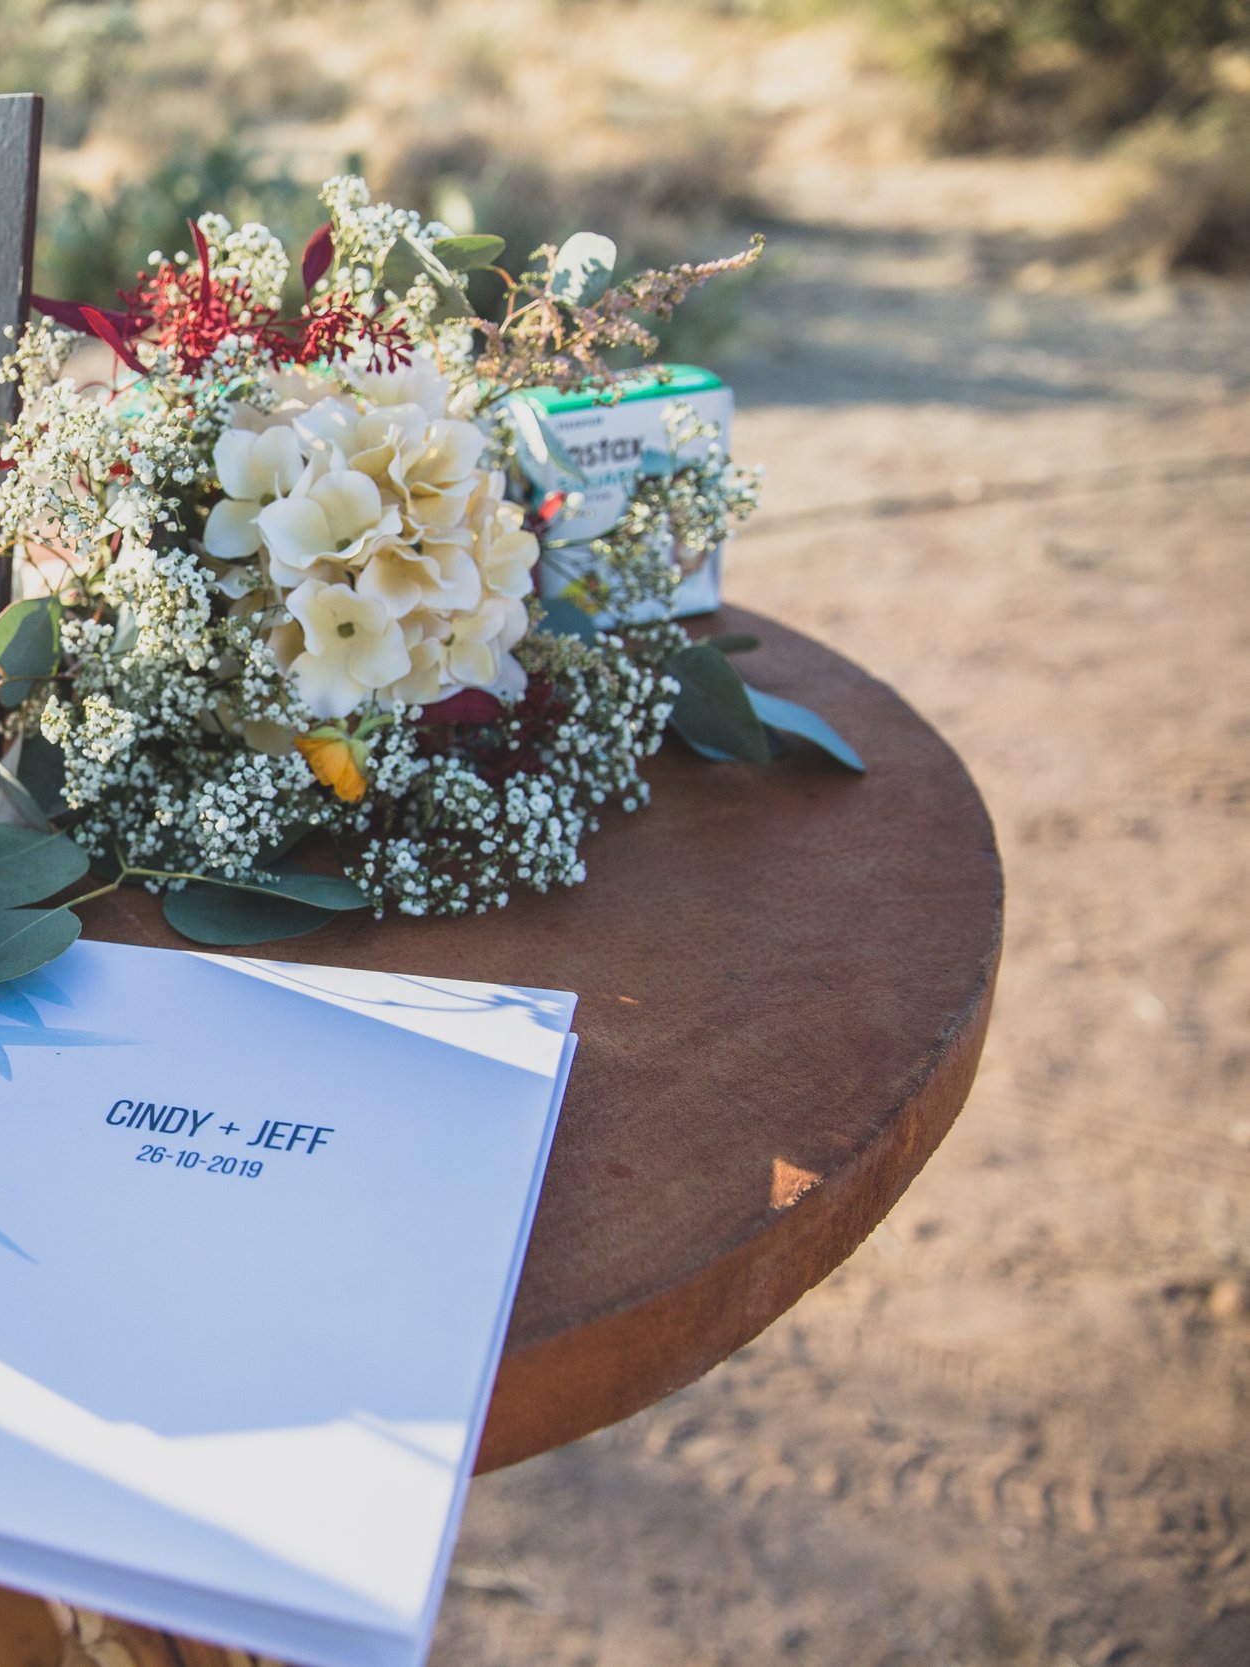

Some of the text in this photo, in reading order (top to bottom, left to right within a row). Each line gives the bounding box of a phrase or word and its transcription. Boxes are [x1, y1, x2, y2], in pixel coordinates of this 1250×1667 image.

[105, 1099, 335, 1155] CINDY + JEFF
[135, 1144, 264, 1179] 26-10-2019
